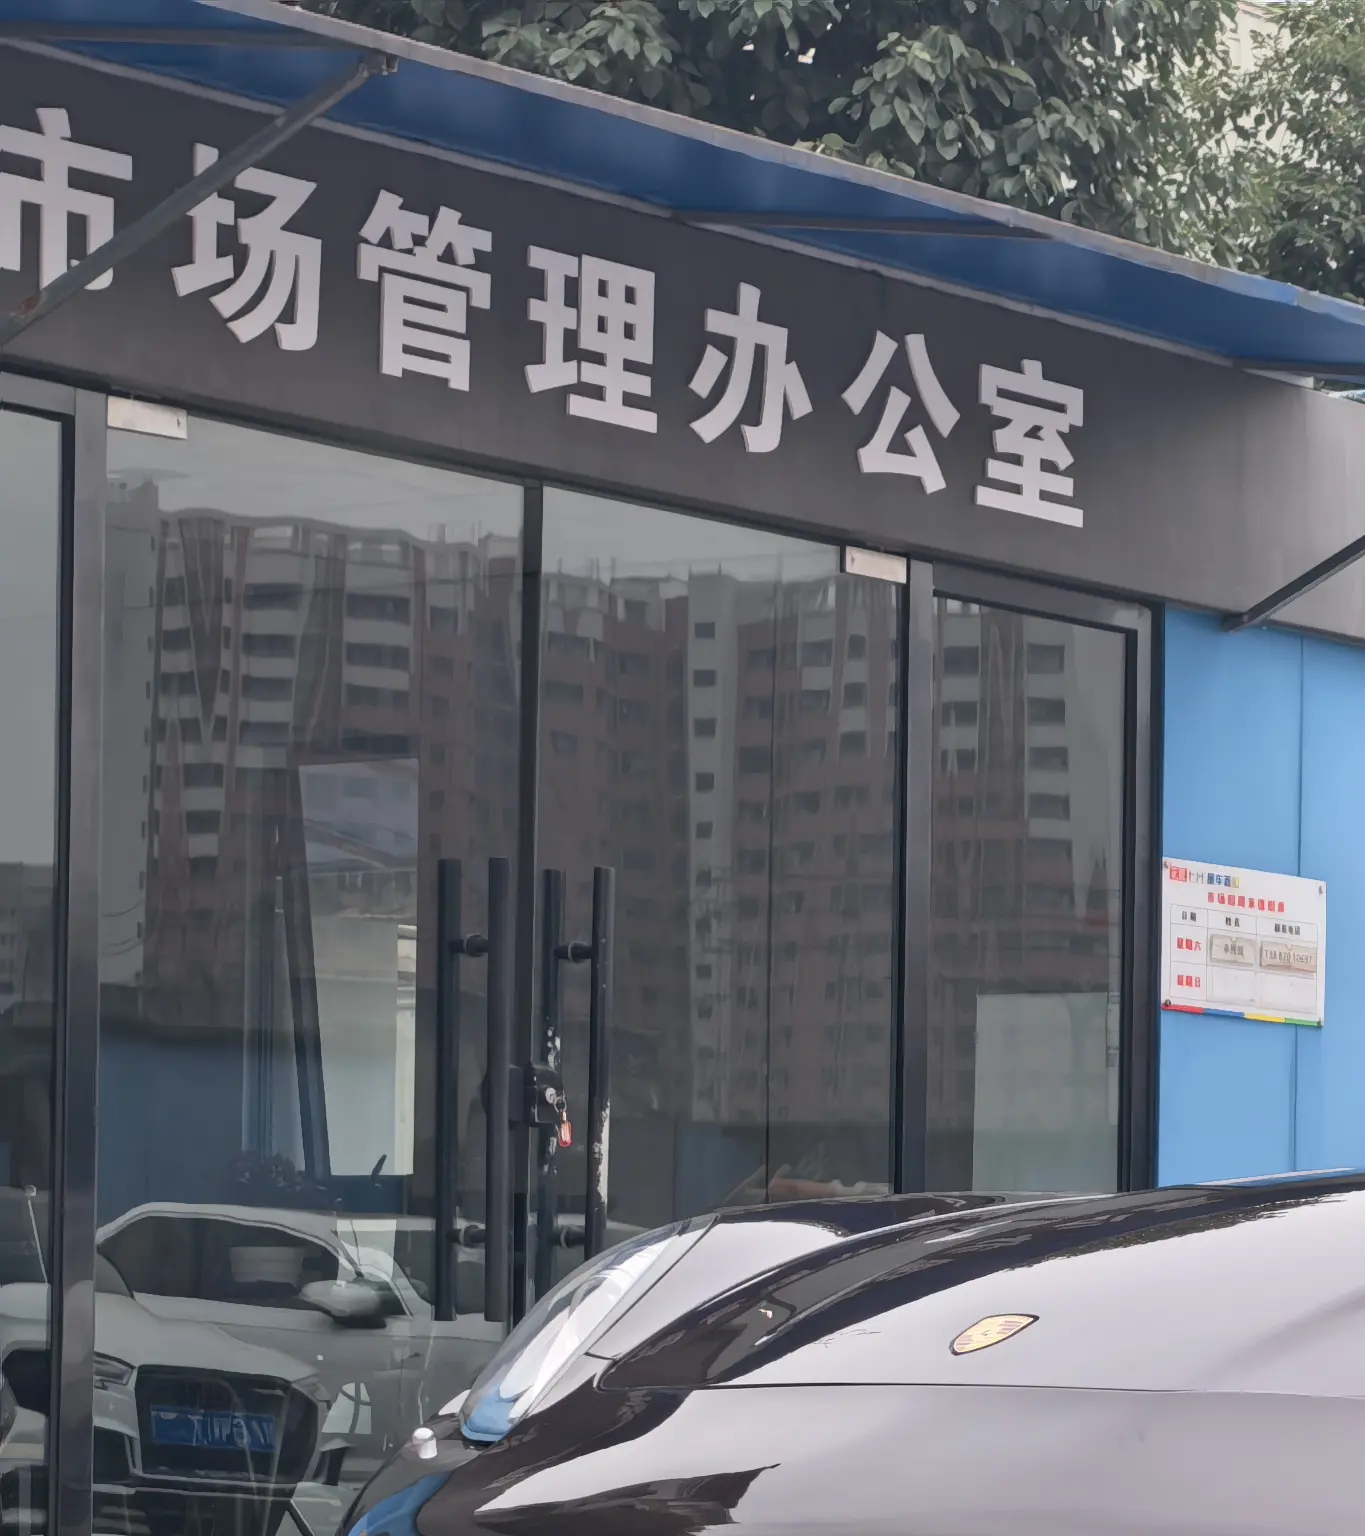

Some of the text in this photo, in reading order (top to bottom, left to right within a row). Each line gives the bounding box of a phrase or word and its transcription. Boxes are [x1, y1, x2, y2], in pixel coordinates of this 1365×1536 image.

[0, 107, 1084, 528] 市场管理办公室
